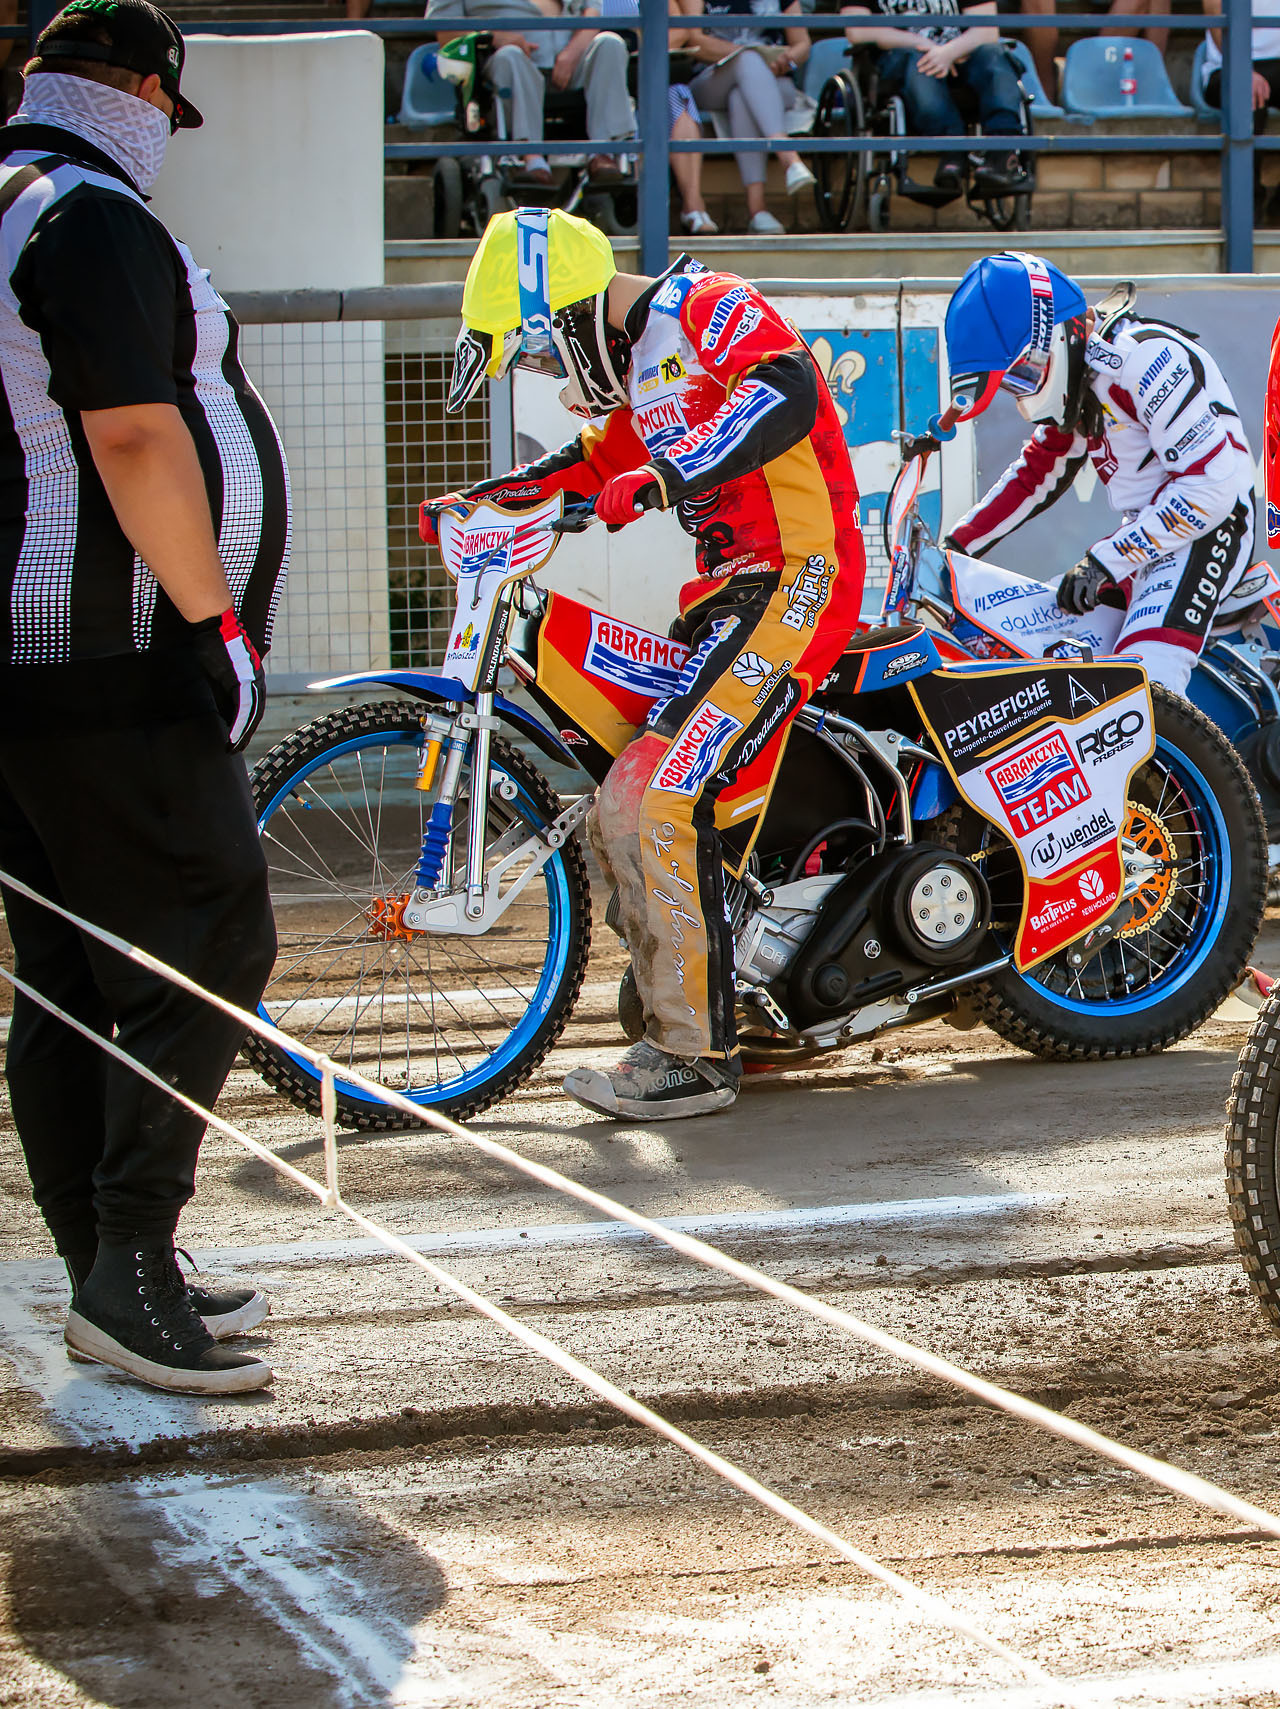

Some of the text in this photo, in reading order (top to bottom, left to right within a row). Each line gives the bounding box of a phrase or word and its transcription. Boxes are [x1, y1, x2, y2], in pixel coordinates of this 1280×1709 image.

[1104, 47, 1117, 63] 6
[637, 401, 681, 437] MCZYK
[1169, 497, 1207, 531] ERGOSS
[1000, 601, 1067, 632] dautkō
[597, 621, 689, 673] ABRAMCZ
[943, 678, 1050, 749] PEYREFICHE
[659, 707, 722, 788] ABRAMCZYK
[1076, 710, 1144, 765] RIGO
[1093, 737, 1134, 767] FRERES
[996, 738, 1064, 787] ABRAMCZYK
[1010, 773, 1088, 832] TEAM
[1061, 808, 1114, 850] wendel
